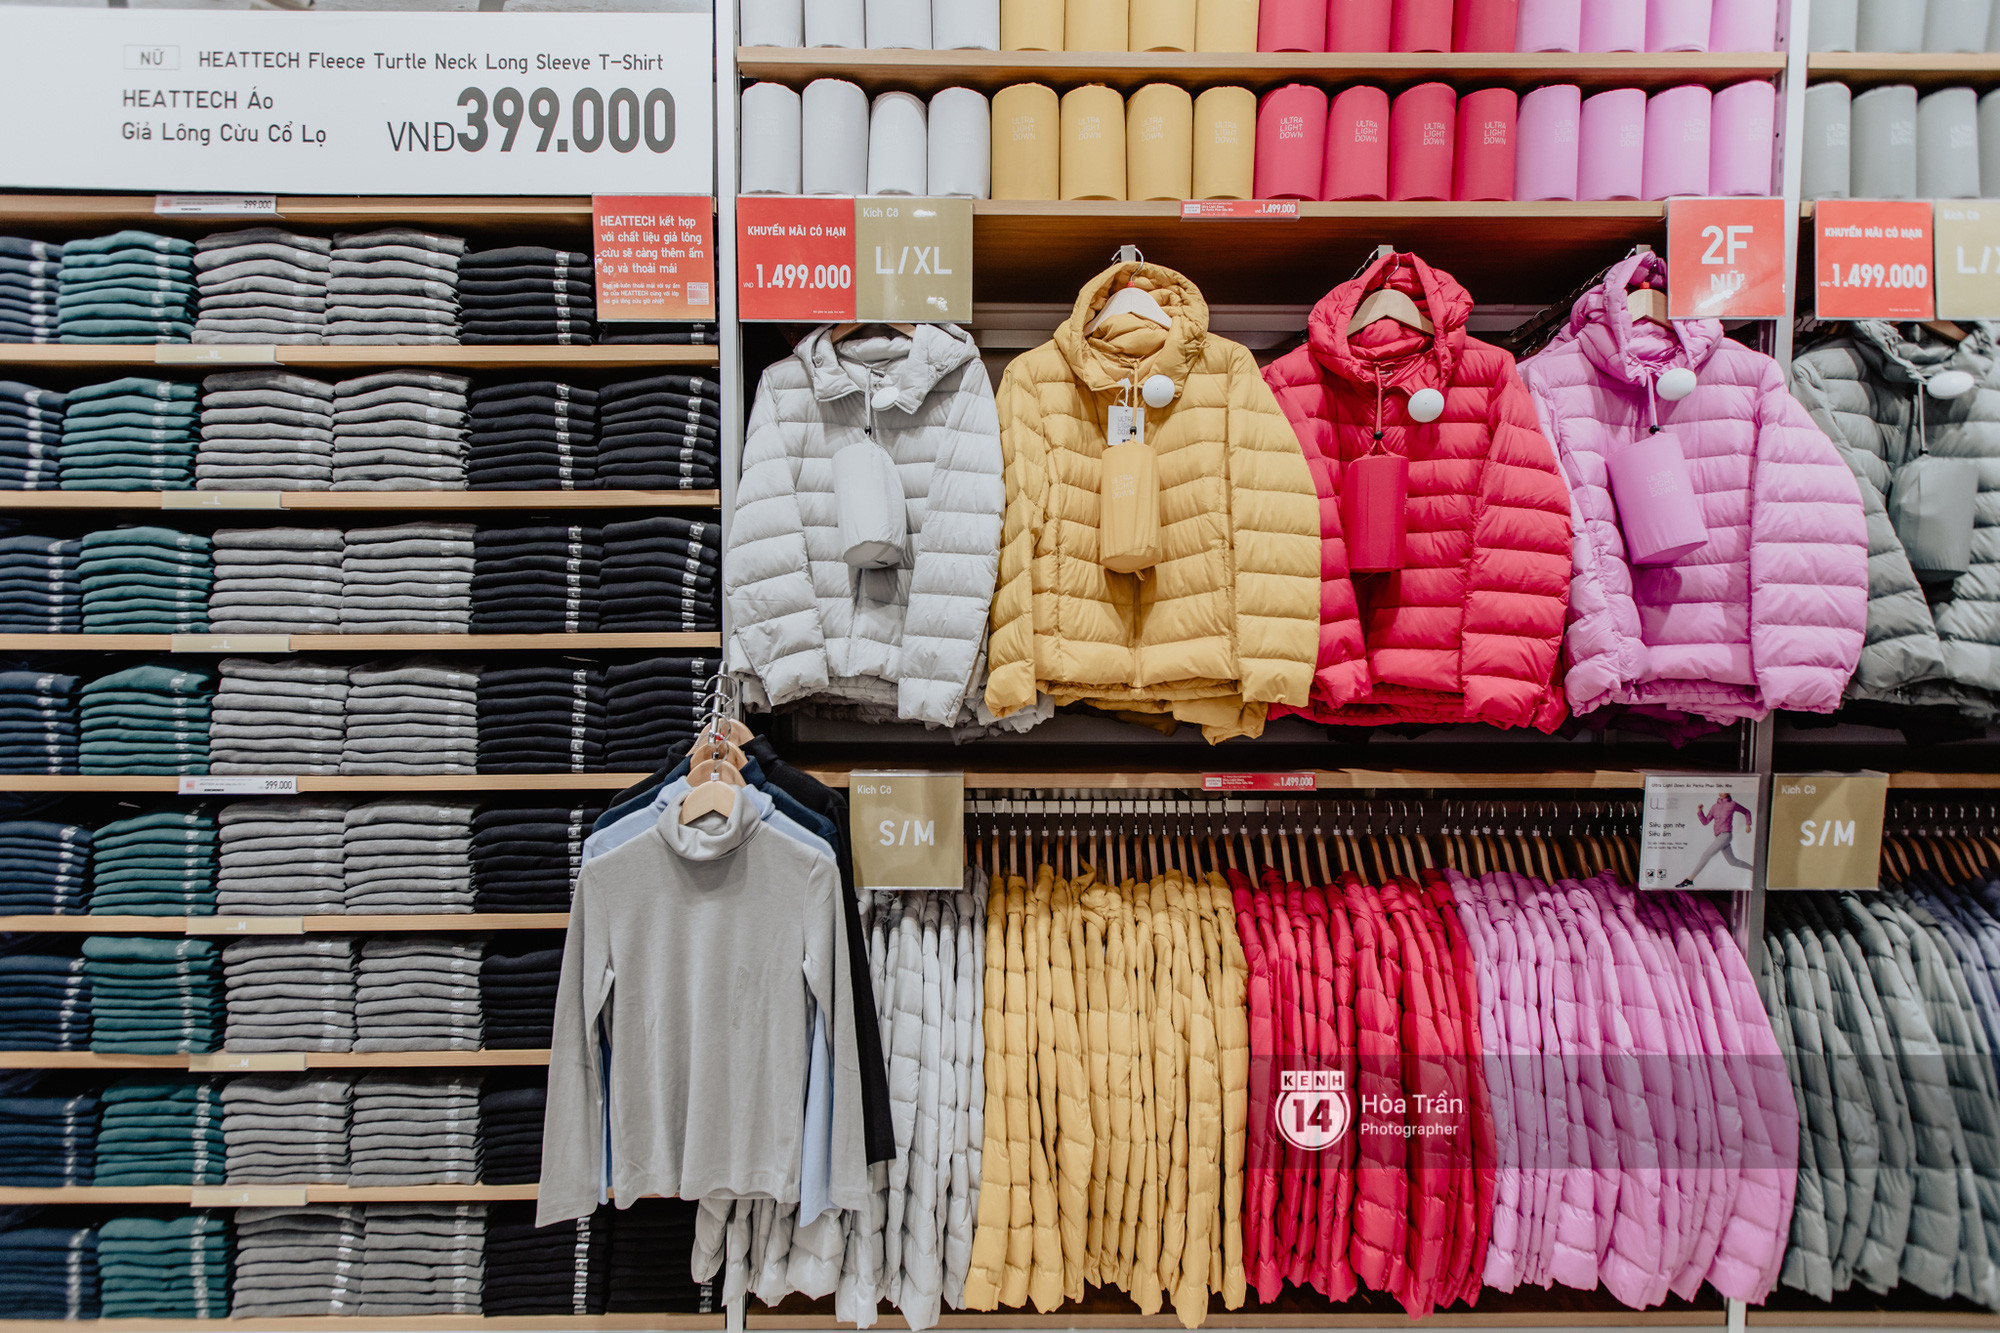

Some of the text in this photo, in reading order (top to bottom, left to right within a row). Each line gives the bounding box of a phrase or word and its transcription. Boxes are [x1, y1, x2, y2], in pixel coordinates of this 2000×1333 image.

[140, 48, 664, 74] NỮ HEATTECH Fleece Turtle Neck Long Sleeve T-Shirt
[122, 85, 274, 109] HEATTECH Áo
[457, 86, 676, 153] 399.000
[1280, 117, 1303, 125] ULTRA
[1356, 120, 1378, 128] ULTRA
[1280, 124, 1303, 132] LIGHT
[1424, 122, 1445, 130] ULTRA
[1485, 121, 1506, 129] ULTRA
[121, 120, 327, 147] Giả Lông Cừu Cổ Lọ
[1215, 128, 1237, 136] LIGHT
[1279, 131, 1303, 139] DOWN
[1355, 127, 1378, 135] LIGHT
[1424, 129, 1445, 138] LIGHT
[1484, 128, 1506, 137] LIGHT
[1078, 132, 1101, 141] DOWN
[1215, 136, 1238, 144] DOWN
[1355, 135, 1378, 143] DOWN
[1423, 137, 1445, 145] DOWN
[1484, 136, 1506, 145] DOWN
[243, 199, 272, 209] 399.000
[1262, 203, 1297, 214] 1.499.000
[600, 214, 696, 229] HEATTECH kết hợp
[747, 222, 846, 239] KHUYẾN MÃI CÓ HẠN
[601, 230, 702, 245] với chất liệu giả lông
[1701, 225, 1753, 265] 2F
[635, 247, 658, 260] càng
[661, 247, 685, 258] thêm
[688, 246, 704, 258] ấm
[602, 262, 677, 275] áp và thoải mái
[756, 263, 852, 290] 1.499.000
[1832, 263, 1928, 290] 1.499.000
[265, 780, 293, 790] 399.000
[1281, 776, 1314, 787] 1.499.000
[879, 820, 935, 847] S/M
[1800, 820, 1855, 847] S/M
